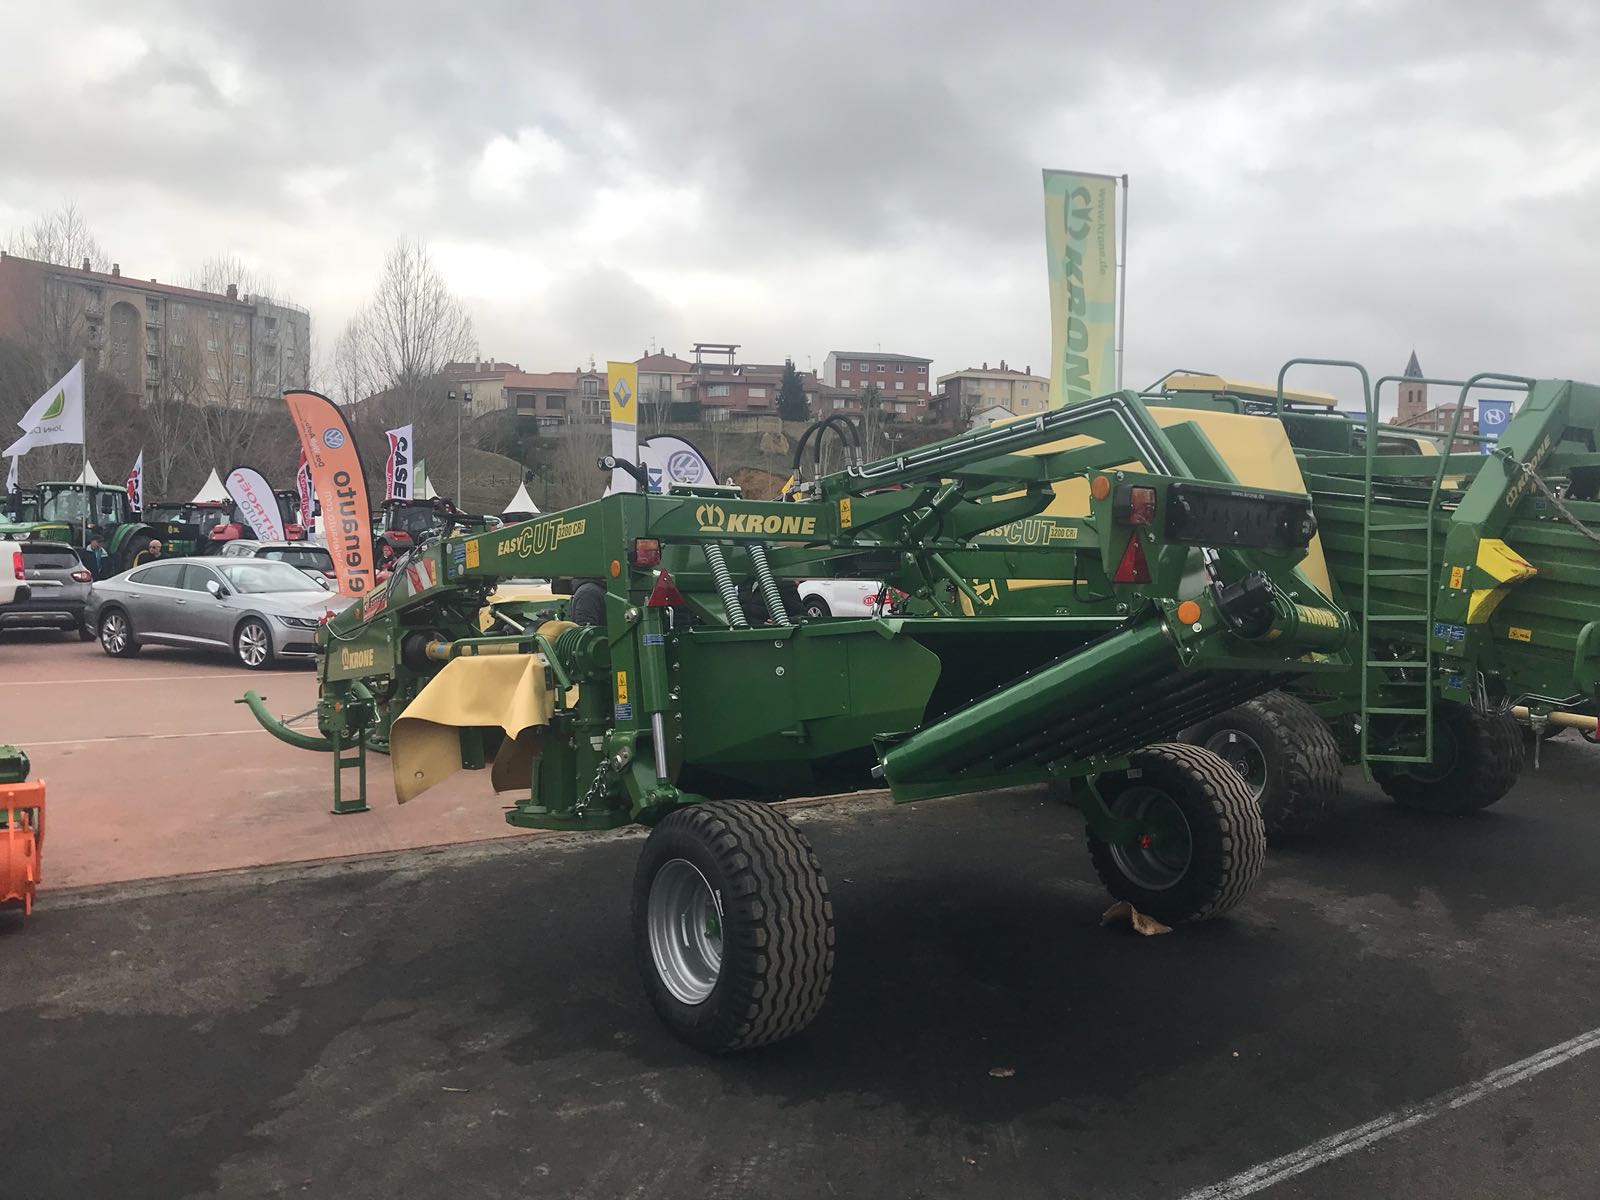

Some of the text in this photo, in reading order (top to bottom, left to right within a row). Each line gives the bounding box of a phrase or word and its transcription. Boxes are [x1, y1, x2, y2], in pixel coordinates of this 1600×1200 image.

[1096, 188, 1106, 276] www.krone.de
[393, 436, 408, 498] CASE
[557, 524, 572, 539] 3200
[726, 514, 817, 535] KRONE
[1050, 528, 1064, 538] 3200
[350, 649, 375, 669] KRONE
